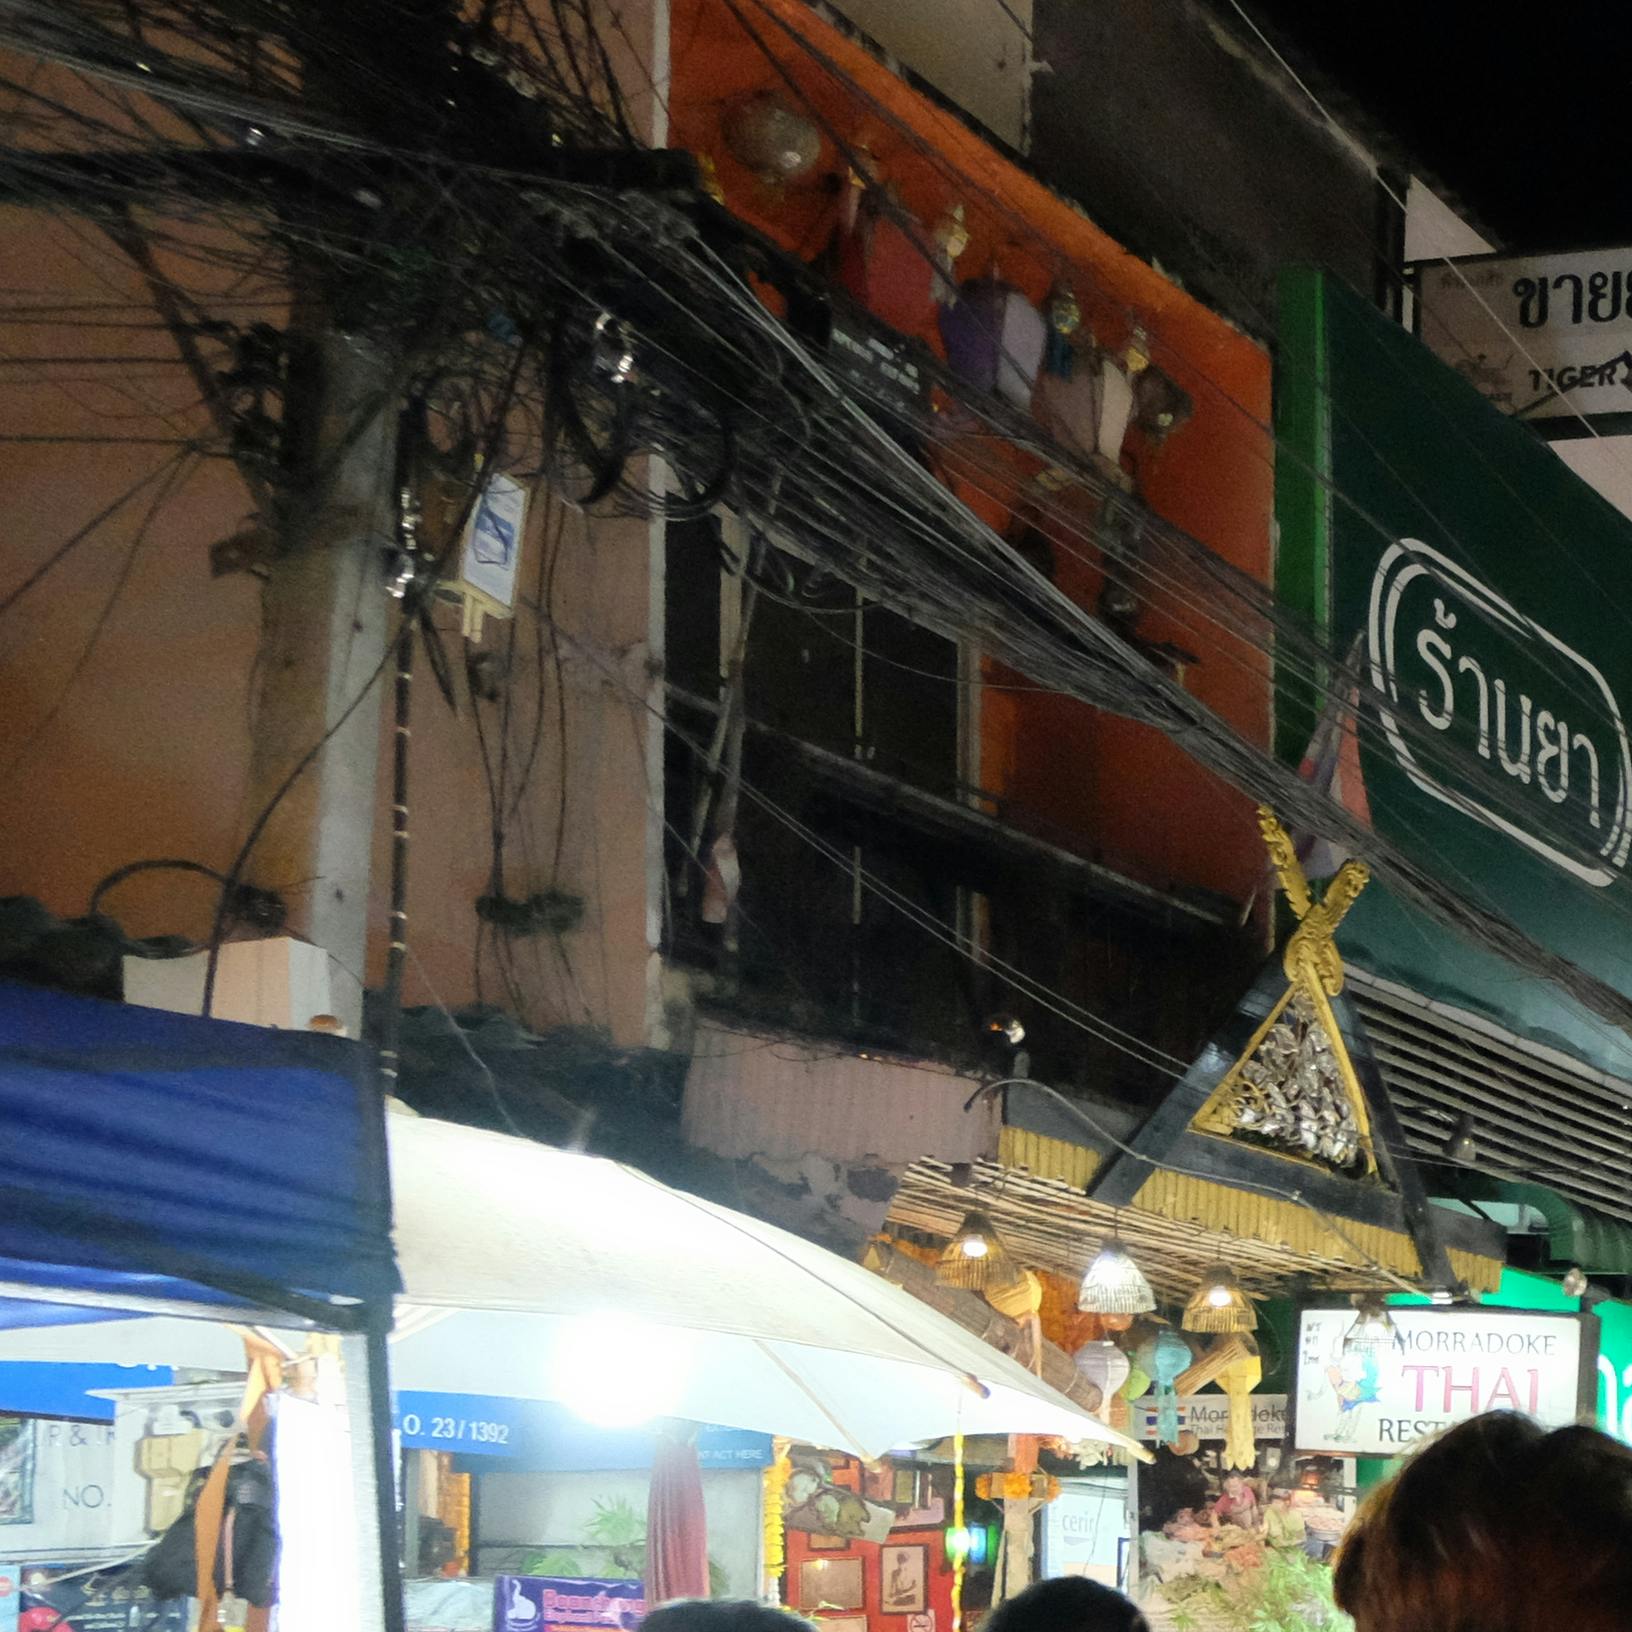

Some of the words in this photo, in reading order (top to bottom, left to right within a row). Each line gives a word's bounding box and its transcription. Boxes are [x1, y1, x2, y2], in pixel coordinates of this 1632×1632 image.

[1528, 362, 1618, 393] TIGER
[1415, 598, 1601, 829] ร้านยา
[1393, 1330, 1557, 1356] MORRADOKE
[1401, 1364, 1539, 1414] THAI
